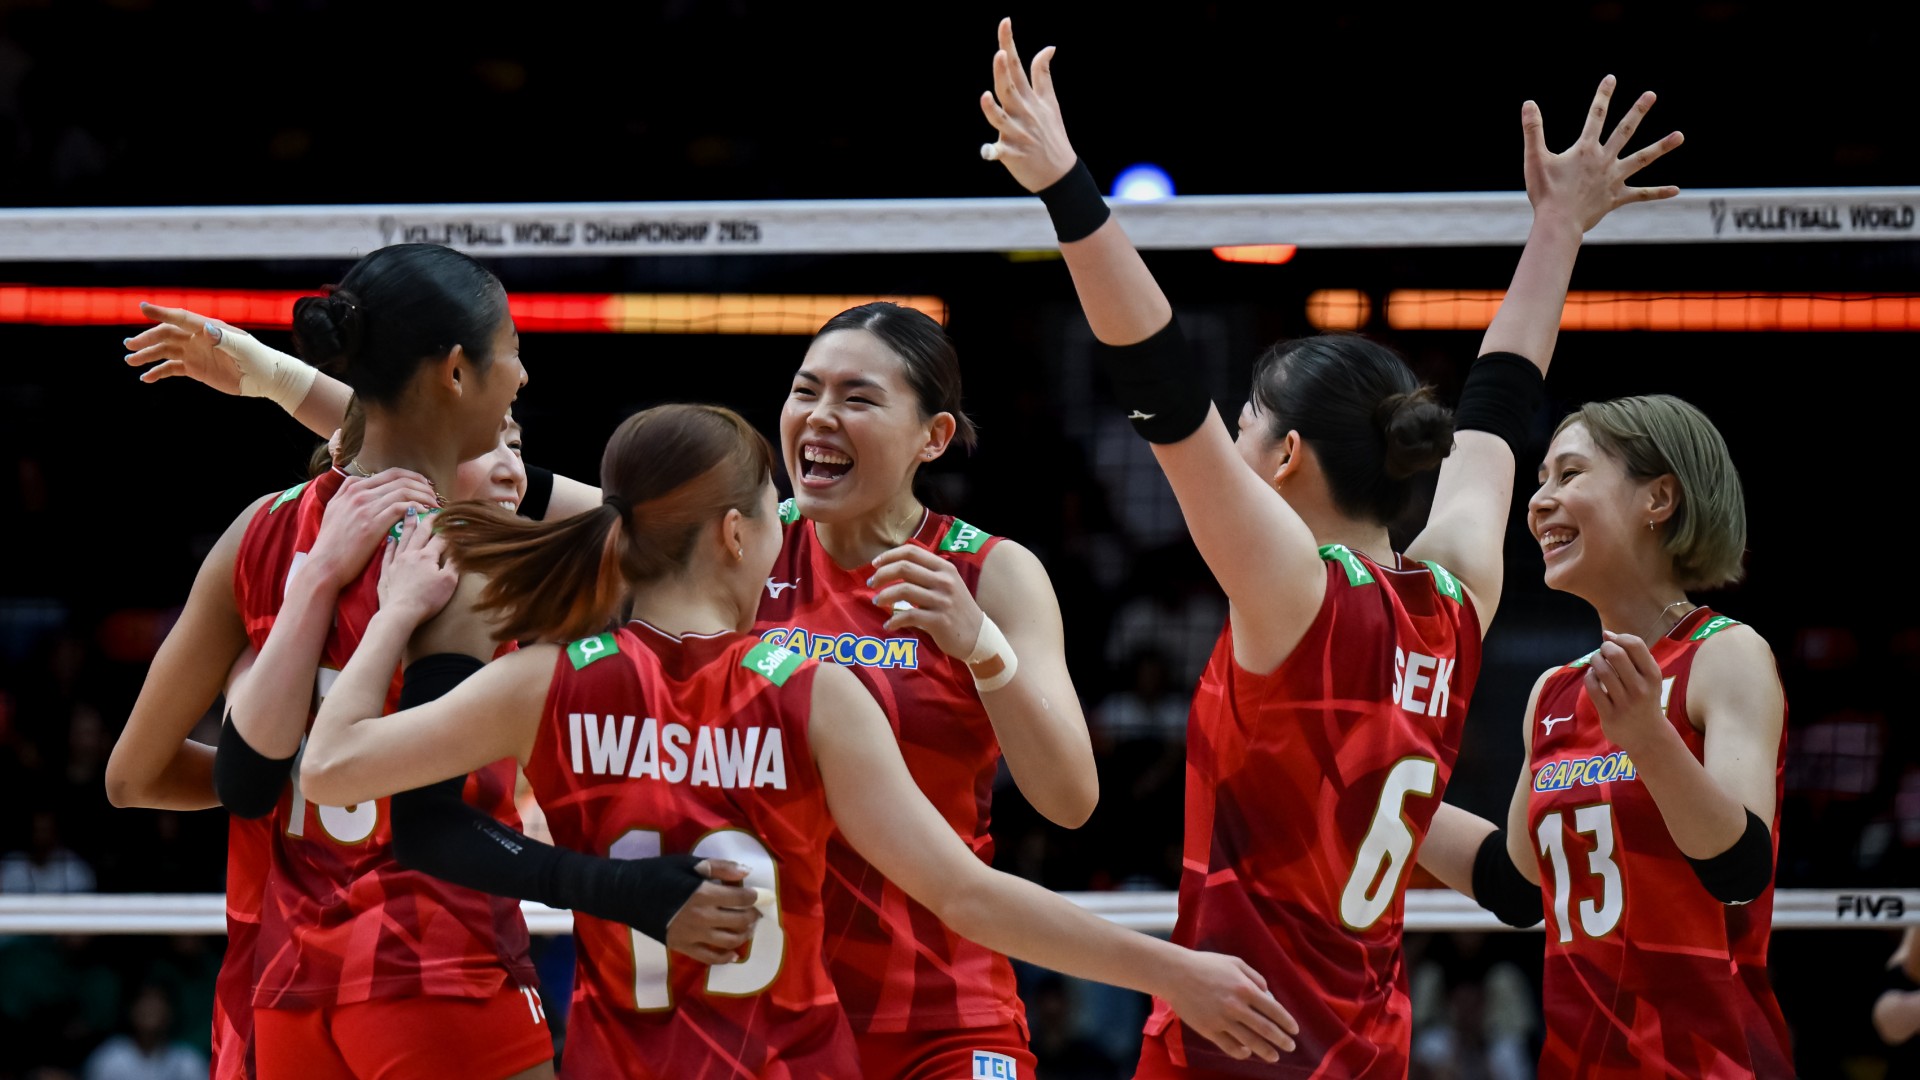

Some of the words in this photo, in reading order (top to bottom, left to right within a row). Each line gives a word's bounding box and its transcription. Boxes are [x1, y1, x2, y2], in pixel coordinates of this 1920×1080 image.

[514, 221, 575, 244] WORLD
[1732, 206, 1842, 230] VOLLEYBALL
[1850, 204, 1916, 229] WORLD
[760, 627, 918, 669] CAPCOM
[568, 713, 788, 791] IWASAWA
[1534, 751, 1637, 793] CAPCOM
[1339, 756, 1438, 930] 6
[1536, 802, 1625, 944] 13
[1837, 895, 1905, 918] FIVB
[974, 1055, 1016, 1080] TEL
